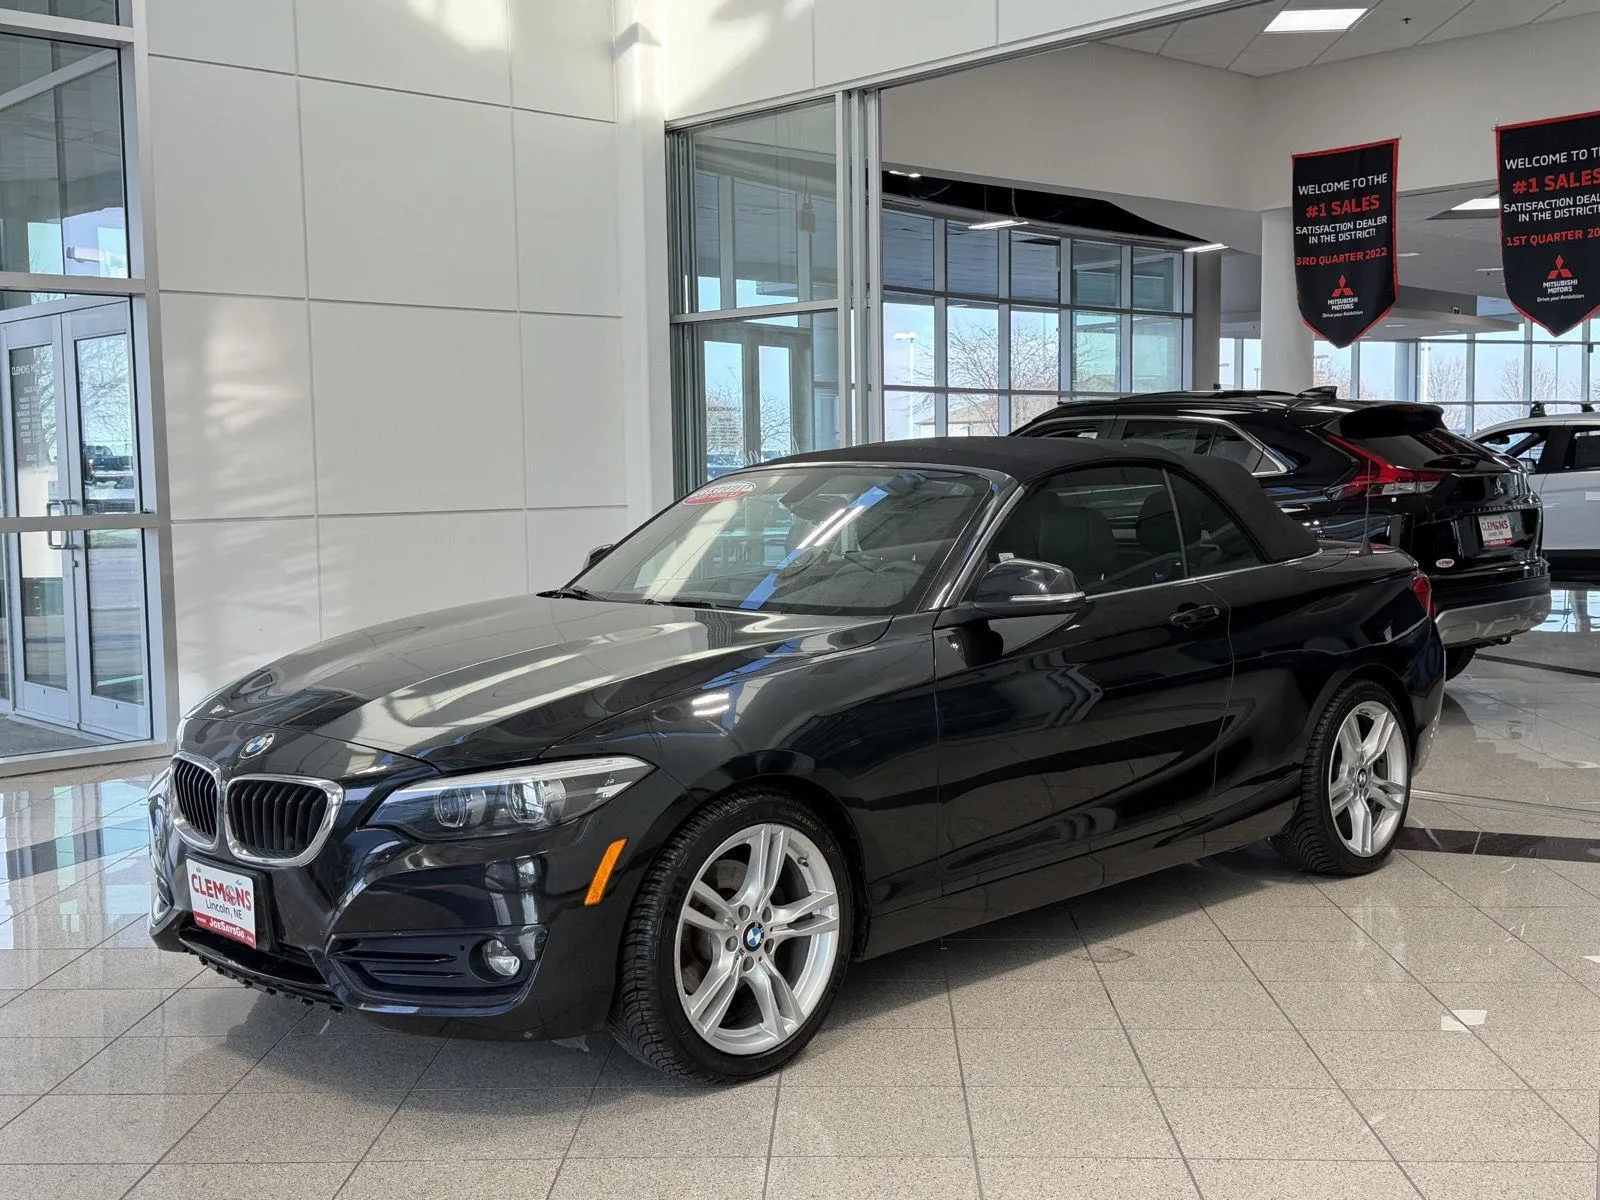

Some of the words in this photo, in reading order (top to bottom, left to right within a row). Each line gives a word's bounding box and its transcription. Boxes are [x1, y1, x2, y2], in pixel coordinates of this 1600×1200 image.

[1505, 152, 1568, 170] WELCOME
[1571, 149, 1588, 161] TO
[1298, 180, 1350, 195] WELCOME
[1352, 177, 1366, 188] TO
[1368, 172, 1388, 186] THE
[1512, 177, 1539, 194] #1
[1544, 168, 1600, 191] SALES
[1305, 202, 1327, 218] #1
[1331, 194, 1380, 216] SALES
[1503, 196, 1573, 213] SATISFACTION
[1295, 221, 1353, 235] SATISFACTION
[1356, 215, 1387, 229] DEALER
[1518, 213, 1529, 222] IN
[1532, 210, 1552, 221] THE
[1309, 235, 1318, 244] IN
[1320, 234, 1336, 243] THE
[1338, 227, 1376, 242] DISTRICT!
[1506, 235, 1527, 247] 1ST
[1529, 229, 1583, 246] QUARTER
[1296, 256, 1316, 266] 3RD
[1319, 251, 1364, 266] QUARTER
[1365, 247, 1387, 260] 2022
[1543, 279, 1578, 288] MITSUBISHI
[1548, 286, 1573, 294] MOTORS
[1328, 297, 1359, 305] MITSUBISHI
[191, 873, 252, 911] CLEMONS
[205, 900, 233, 918] Lincoln,
[233, 907, 243, 920] NE
